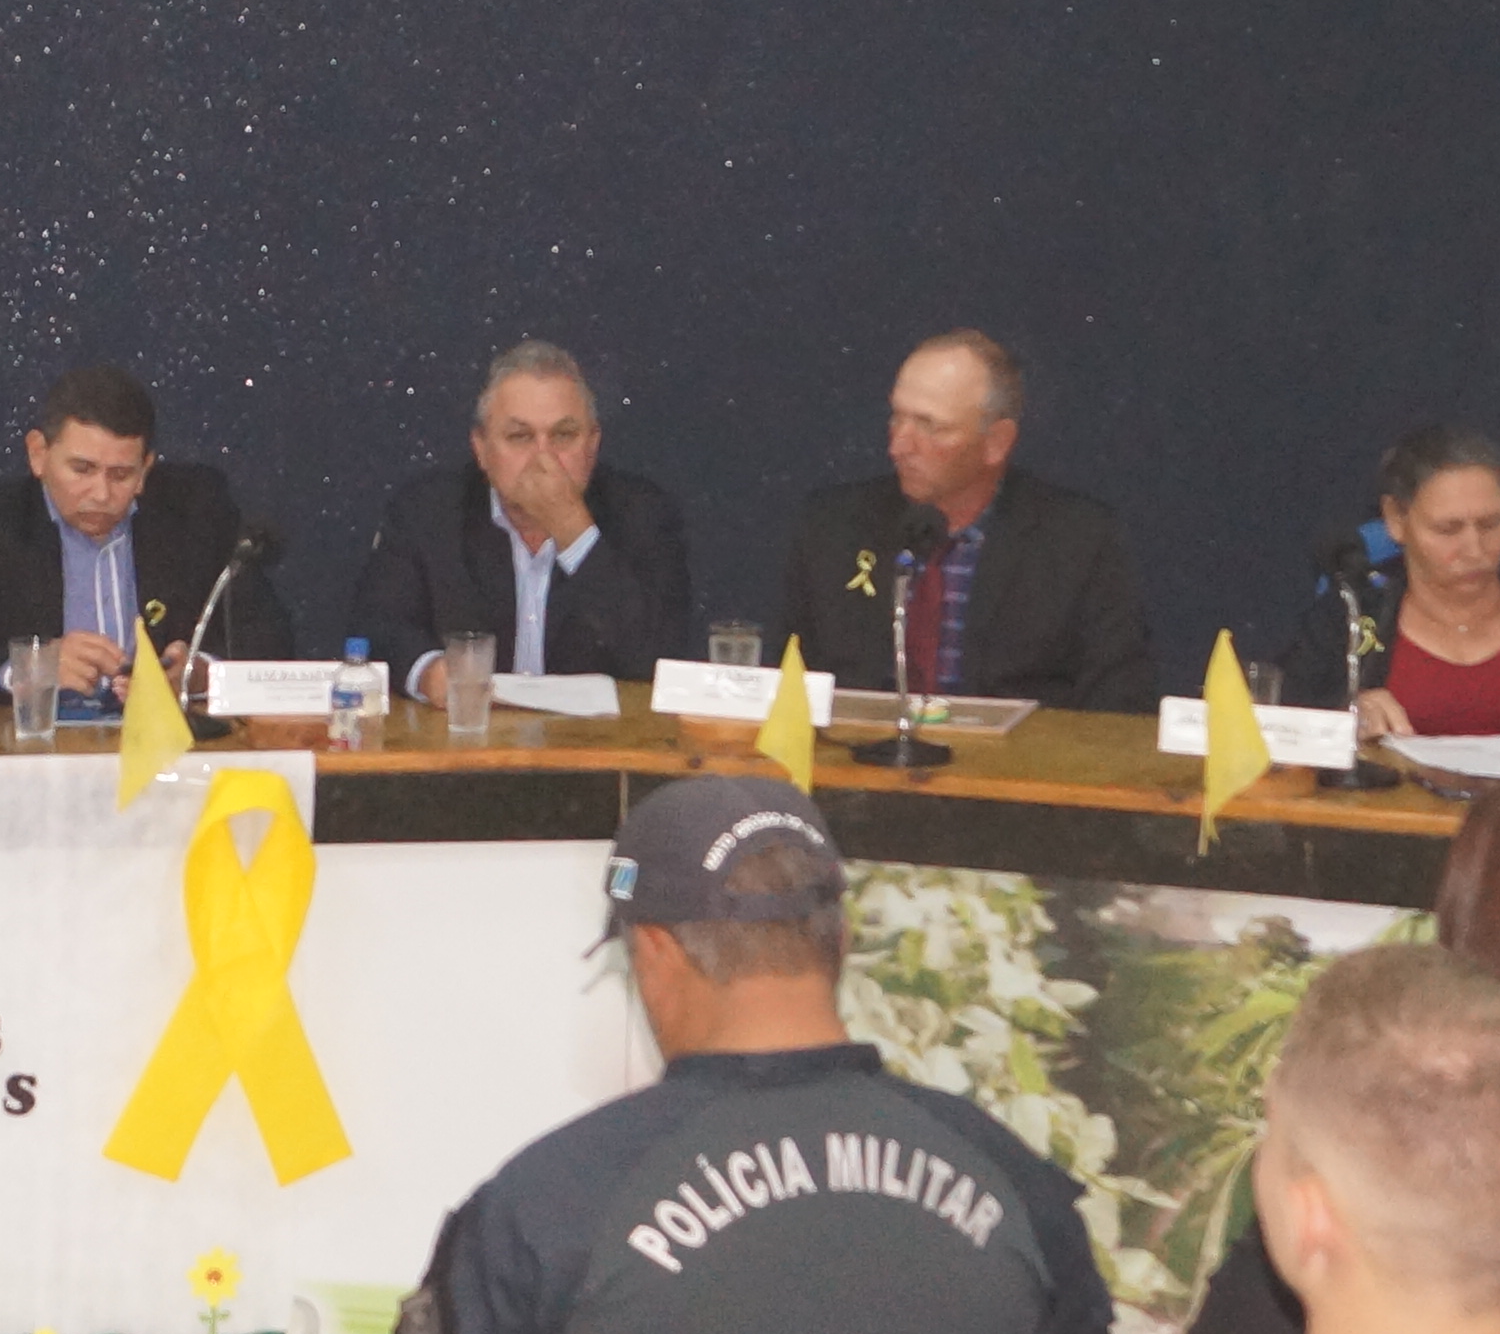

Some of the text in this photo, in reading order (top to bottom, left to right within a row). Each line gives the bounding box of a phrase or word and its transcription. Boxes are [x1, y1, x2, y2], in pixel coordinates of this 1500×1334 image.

[702, 832, 737, 872] MATO
[627, 1131, 1005, 1274] POLÍCIA MILITAR
